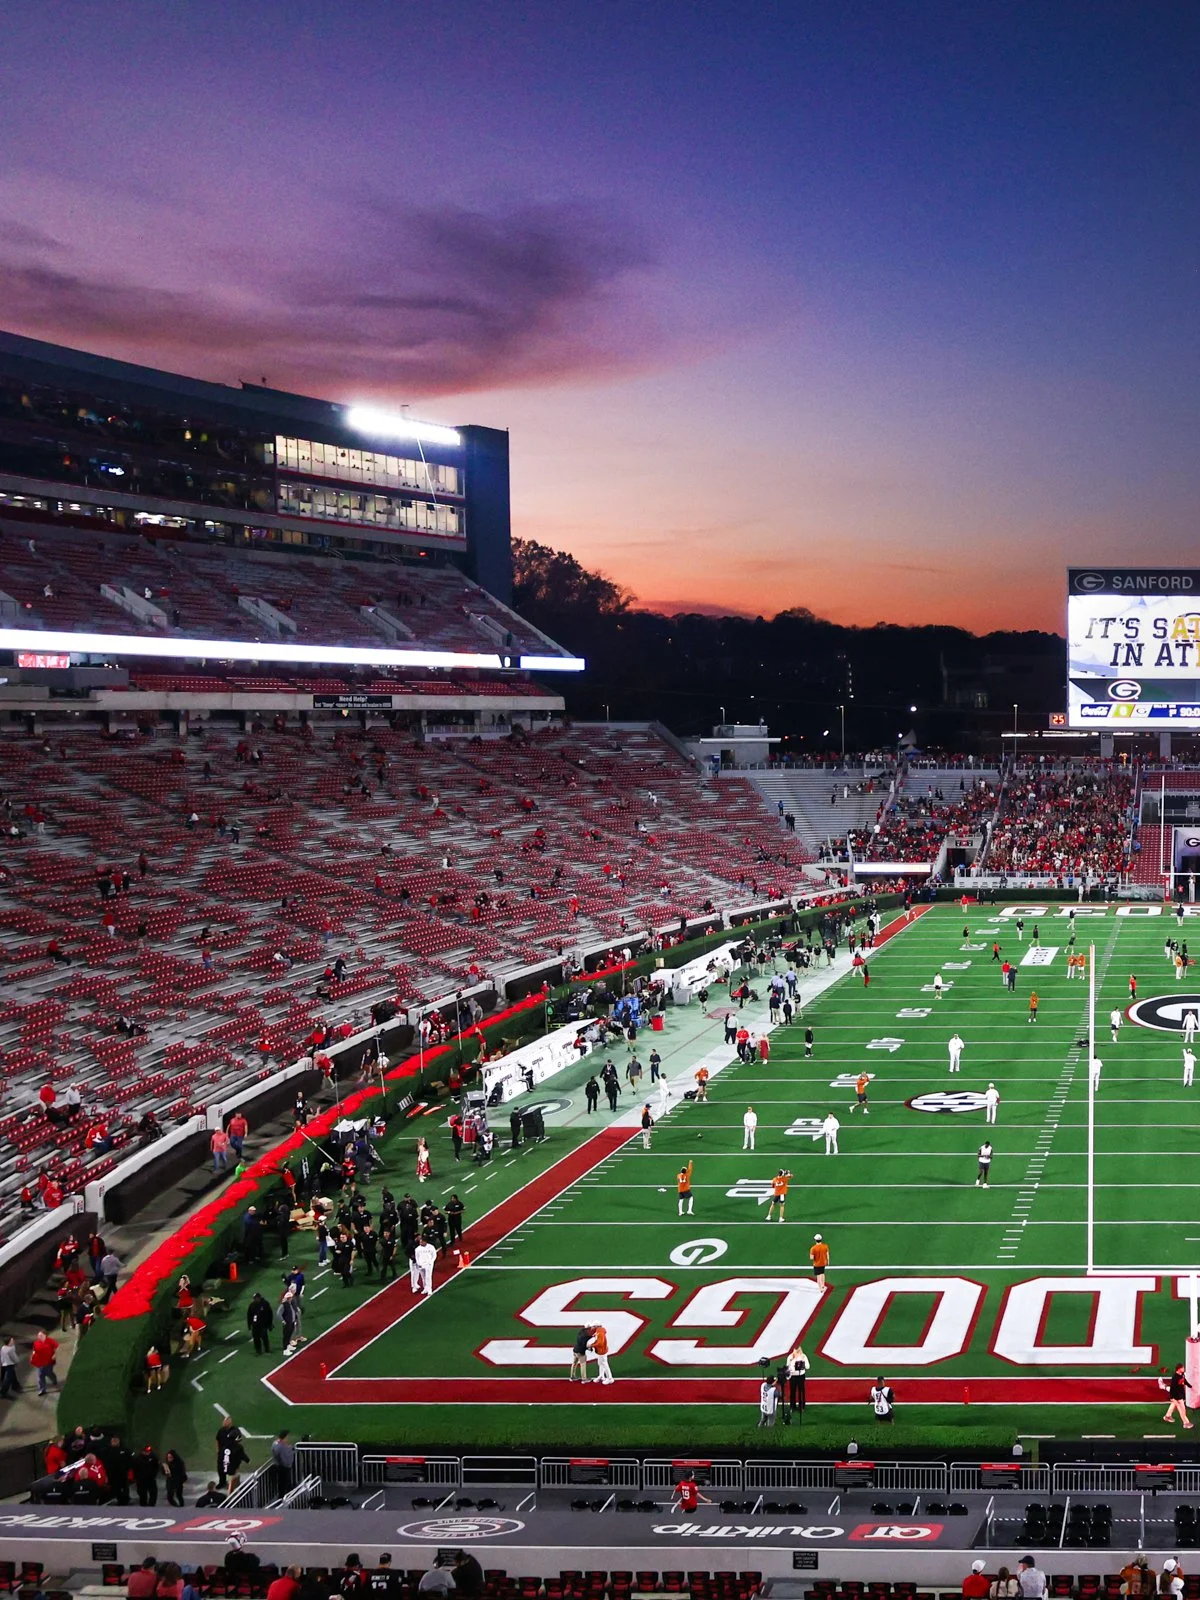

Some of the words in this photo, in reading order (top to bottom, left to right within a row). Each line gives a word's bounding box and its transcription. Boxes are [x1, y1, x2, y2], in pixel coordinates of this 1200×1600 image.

[1112, 576, 1193, 590] SANFORD
[1085, 617, 1140, 639] IT'S
[1109, 642, 1145, 667] IN
[1110, 681, 1140, 700] G
[1052, 715, 1065, 725] 25
[669, 1237, 728, 1266] G
[185, 1519, 264, 1531] QT
[651, 1522, 845, 1539] QuikTrip
[864, 1525, 932, 1539] QT
